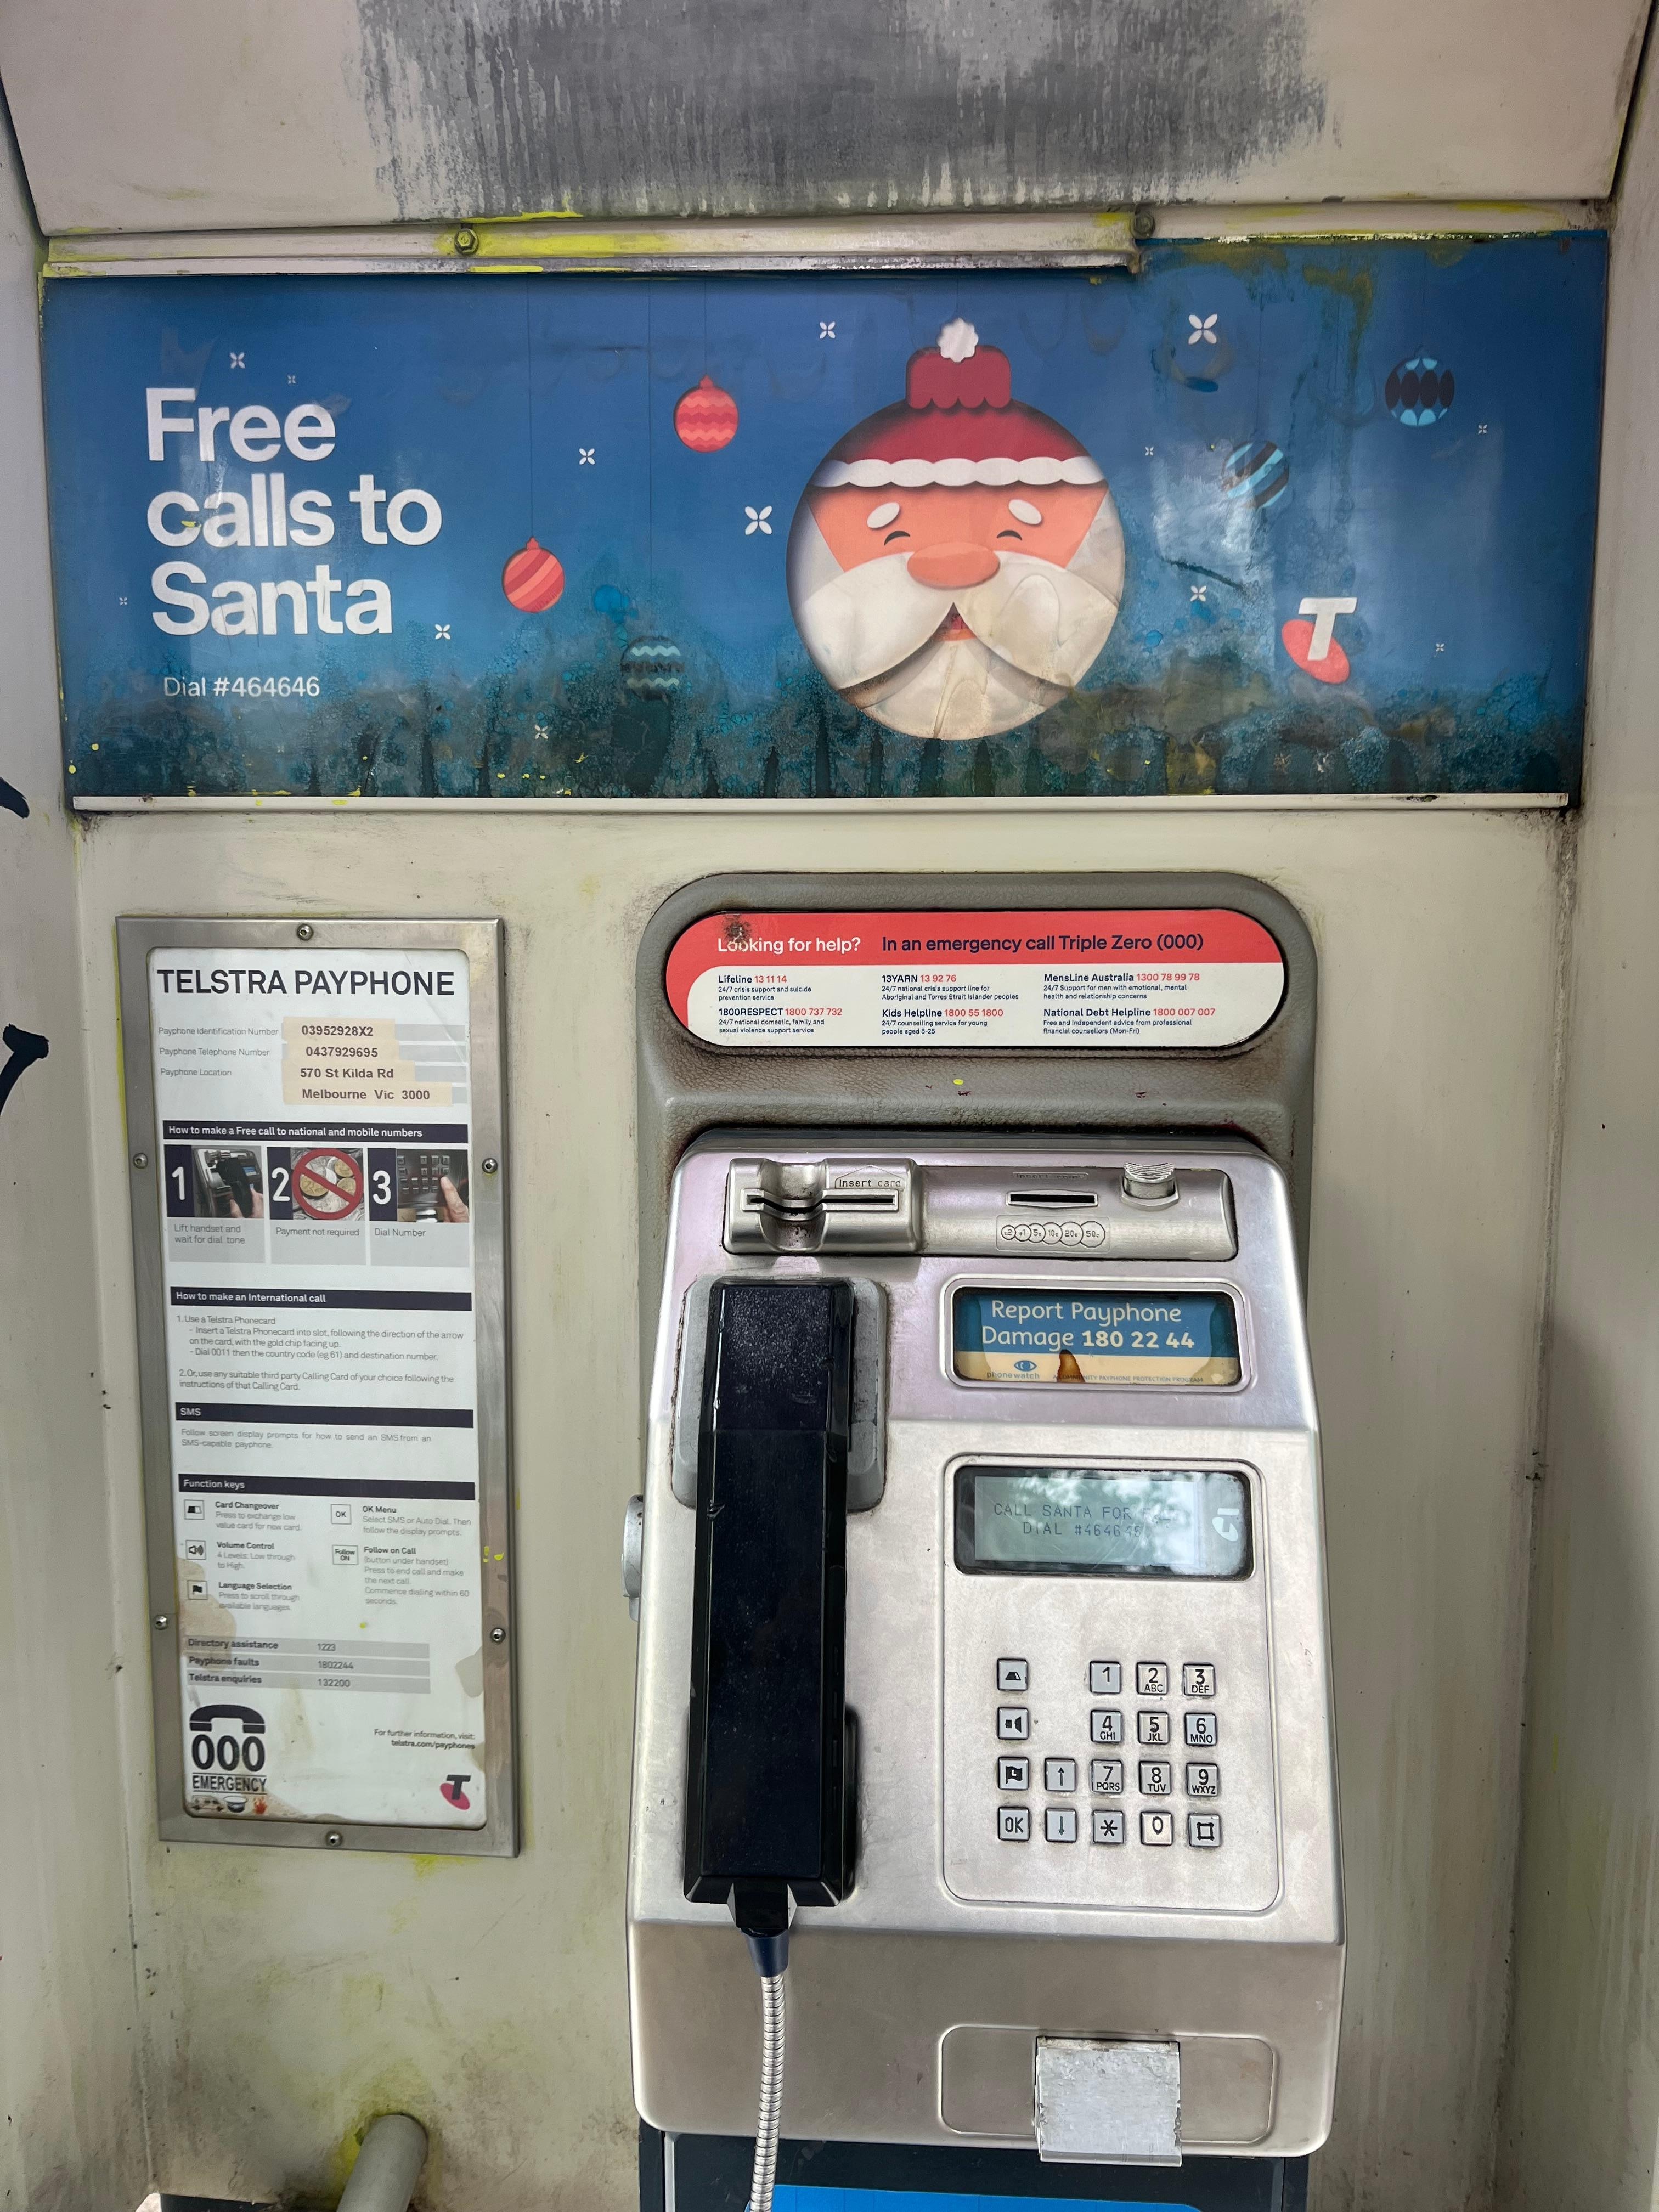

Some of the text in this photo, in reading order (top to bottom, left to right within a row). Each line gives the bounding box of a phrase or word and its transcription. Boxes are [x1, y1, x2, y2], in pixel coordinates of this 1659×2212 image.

[146, 388, 336, 462] Free
[147, 473, 442, 547] calls to
[151, 561, 392, 635] Santa
[163, 677, 320, 697] Dial #464646
[718, 936, 860, 954] Looking for help?
[883, 933, 1203, 953] In an emergency call Triple Zero (000)
[156, 969, 454, 995] TELSTRA PAYPHONE
[719, 975, 752, 983] Lifeline
[882, 974, 918, 983] 13YARN
[1044, 973, 1089, 981] MensLine
[1091, 973, 1134, 981] Australia
[1188, 973, 1199, 981] 78
[882, 1008, 901, 1017] Kids
[904, 1008, 942, 1018] Helpline
[1043, 1008, 1083, 1016] National
[1086, 1008, 1109, 1016] Debt
[1111, 1007, 1151, 1018] Helpline
[159, 1026, 195, 1036] Payphone
[197, 1027, 246, 1036] Identification
[302, 1025, 373, 1036] 03952928X2
[159, 1047, 196, 1057] Payphone
[198, 1048, 236, 1056] Telephone
[306, 1046, 377, 1057] 0437929695
[160, 1068, 198, 1077] Payphone
[300, 1068, 393, 1078] 570 St Kilda Rd
[302, 1088, 430, 1099] Melbourne Vic 3000
[201, 1126, 227, 1135] make
[236, 1126, 256, 1135] Free
[288, 1127, 326, 1136] national
[328, 1127, 345, 1136] and
[347, 1127, 379, 1136] mobile
[381, 1128, 422, 1137] numbers
[172, 1166, 185, 1200] 1
[272, 1167, 290, 1201] 2
[373, 1170, 391, 1204] 3
[839, 1178, 871, 1187] Insert
[174, 1223, 241, 1234] Lift handset and
[276, 1227, 311, 1237] Payment
[326, 1228, 359, 1237] required
[375, 1227, 426, 1237] Dial Number
[194, 1235, 205, 1243] for
[226, 1237, 245, 1246] tone
[176, 1291, 195, 1300] How
[209, 1292, 233, 1300] make
[249, 1293, 307, 1302] International
[309, 1294, 326, 1302] call
[992, 1300, 1181, 1327] Report Payphone
[982, 1325, 1195, 1352] Damage 180 22 44
[180, 1407, 201, 1416] SMS
[183, 1479, 245, 1491] Function keys
[992, 1501, 1034, 1519] CALL
[1042, 1502, 1091, 1518] SANTA
[1102, 1504, 1133, 1520] FOR
[1023, 1520, 1062, 1535] DIAL
[188, 1638, 279, 1649] Directory assistance
[317, 1642, 335, 1653] 1223
[189, 1657, 259, 1668] Payphone faults
[318, 1660, 353, 1671] 1802244
[188, 1673, 262, 1684] Telstra enquiries
[1103, 1667, 1110, 1682] 1
[1149, 1668, 1158, 1683] 2
[1195, 1669, 1205, 1685] 3
[318, 1677, 350, 1688] 132200
[1143, 1684, 1163, 1693] ABC
[1103, 1716, 1112, 1731] 4
[1150, 1717, 1159, 1732] 5
[1197, 1718, 1206, 1734] 6
[1100, 1731, 1115, 1740] GHI
[1148, 1732, 1163, 1741] JKL
[1190, 1734, 1212, 1743] MNO
[191, 1734, 266, 1772] 000
[1103, 1766, 1113, 1781] 7
[1152, 1767, 1161, 1783] 8
[1199, 1769, 1208, 1785] 9
[192, 1775, 267, 1792] EMERGENCY
[1095, 1782, 1120, 1791] PQRS
[1147, 1784, 1166, 1792] TUV
[1191, 1785, 1215, 1795] WXYZ
[1005, 1818, 1023, 1833] OK
[1152, 1816, 1163, 1834] 0
